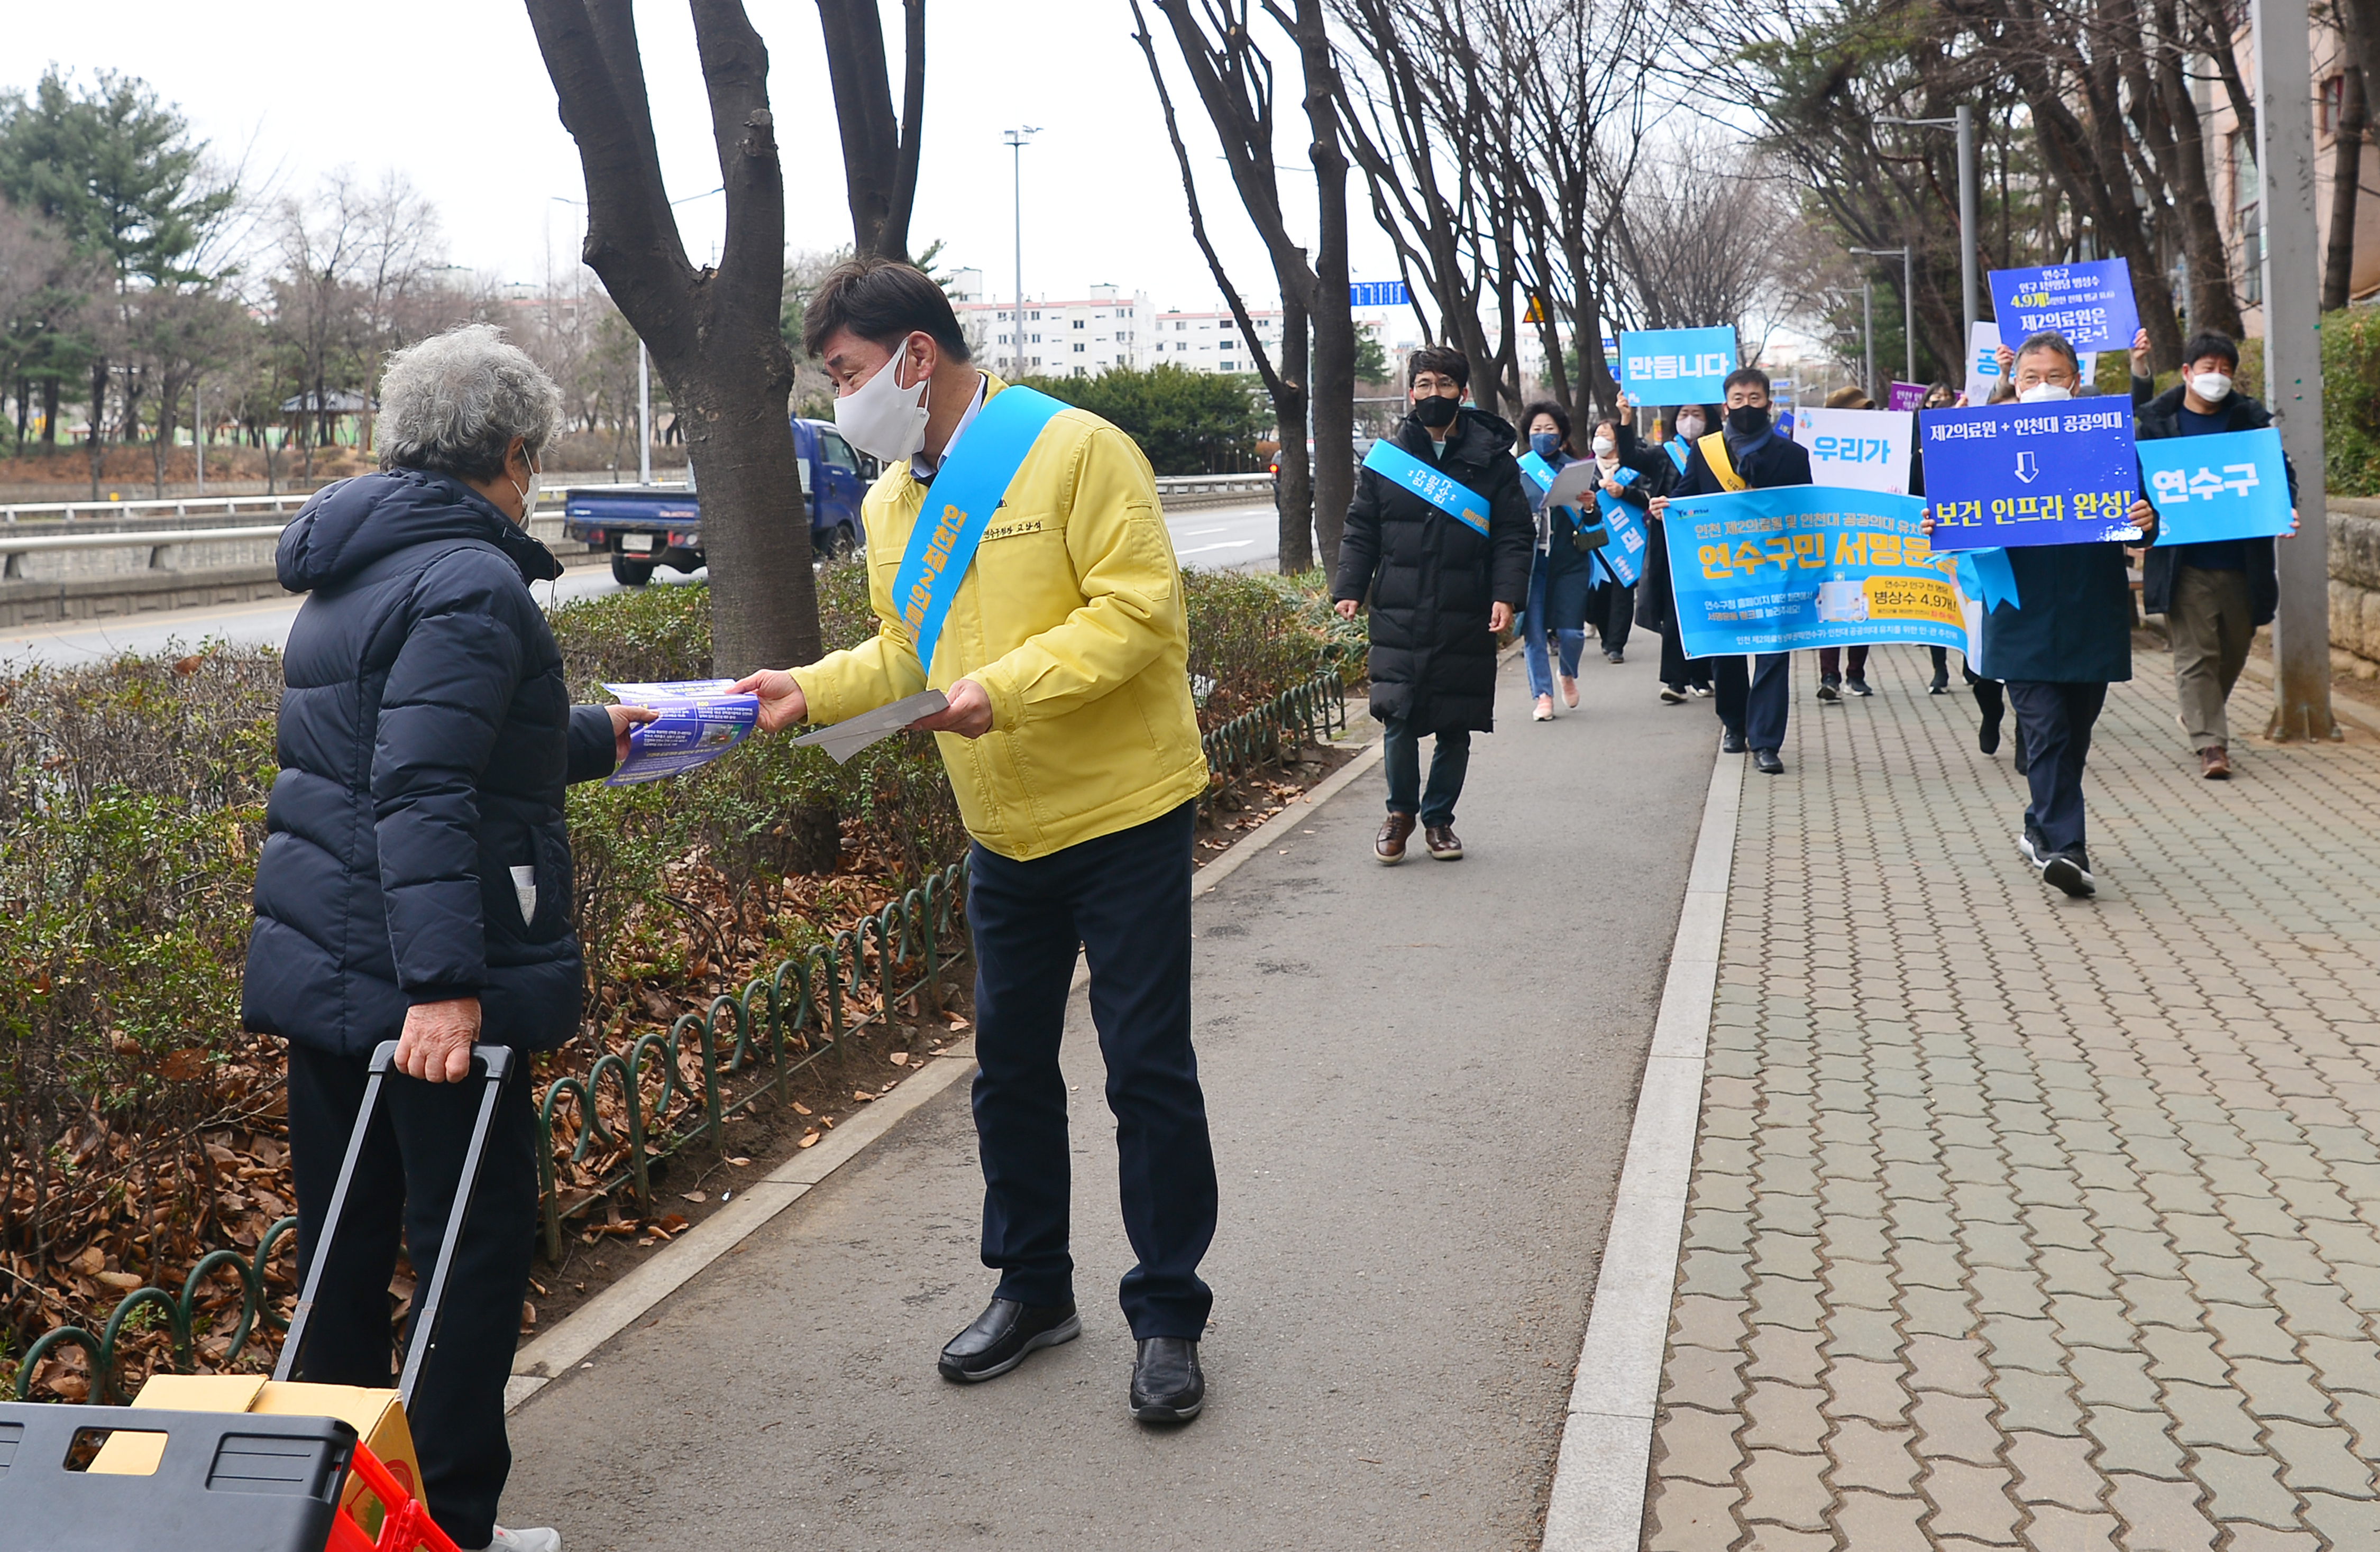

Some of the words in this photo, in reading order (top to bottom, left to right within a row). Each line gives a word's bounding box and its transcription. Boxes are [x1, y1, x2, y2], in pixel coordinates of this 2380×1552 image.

[2019, 282, 2037, 293] 인구
[2042, 268, 2070, 280] 연수구
[2020, 307, 2108, 331] 제2의료원은
[2062, 325, 2109, 345] 구로~!
[1628, 352, 1730, 380] 만듭니다
[1930, 421, 1997, 442] 제2의료원
[2014, 416, 2059, 436] 인천대
[2063, 411, 2123, 433] 공공의대
[1813, 435, 1891, 464] 우리가
[2152, 462, 2260, 504] 연수구
[1936, 500, 1983, 527] 보건
[1991, 494, 2065, 525] 인프라
[2073, 490, 2132, 520] 완성!
[1607, 505, 1645, 554] 미래
[1694, 523, 1722, 539] 인천
[1724, 516, 1783, 535] 제2의료원
[1800, 512, 1839, 528] 인천대
[1843, 512, 1894, 531] 공공의대
[1698, 533, 1826, 580] 연수구민
[1885, 580, 1908, 589] 연수구
[1874, 591, 1917, 605] 병상수
[1920, 593, 1957, 612] 4.9개!
